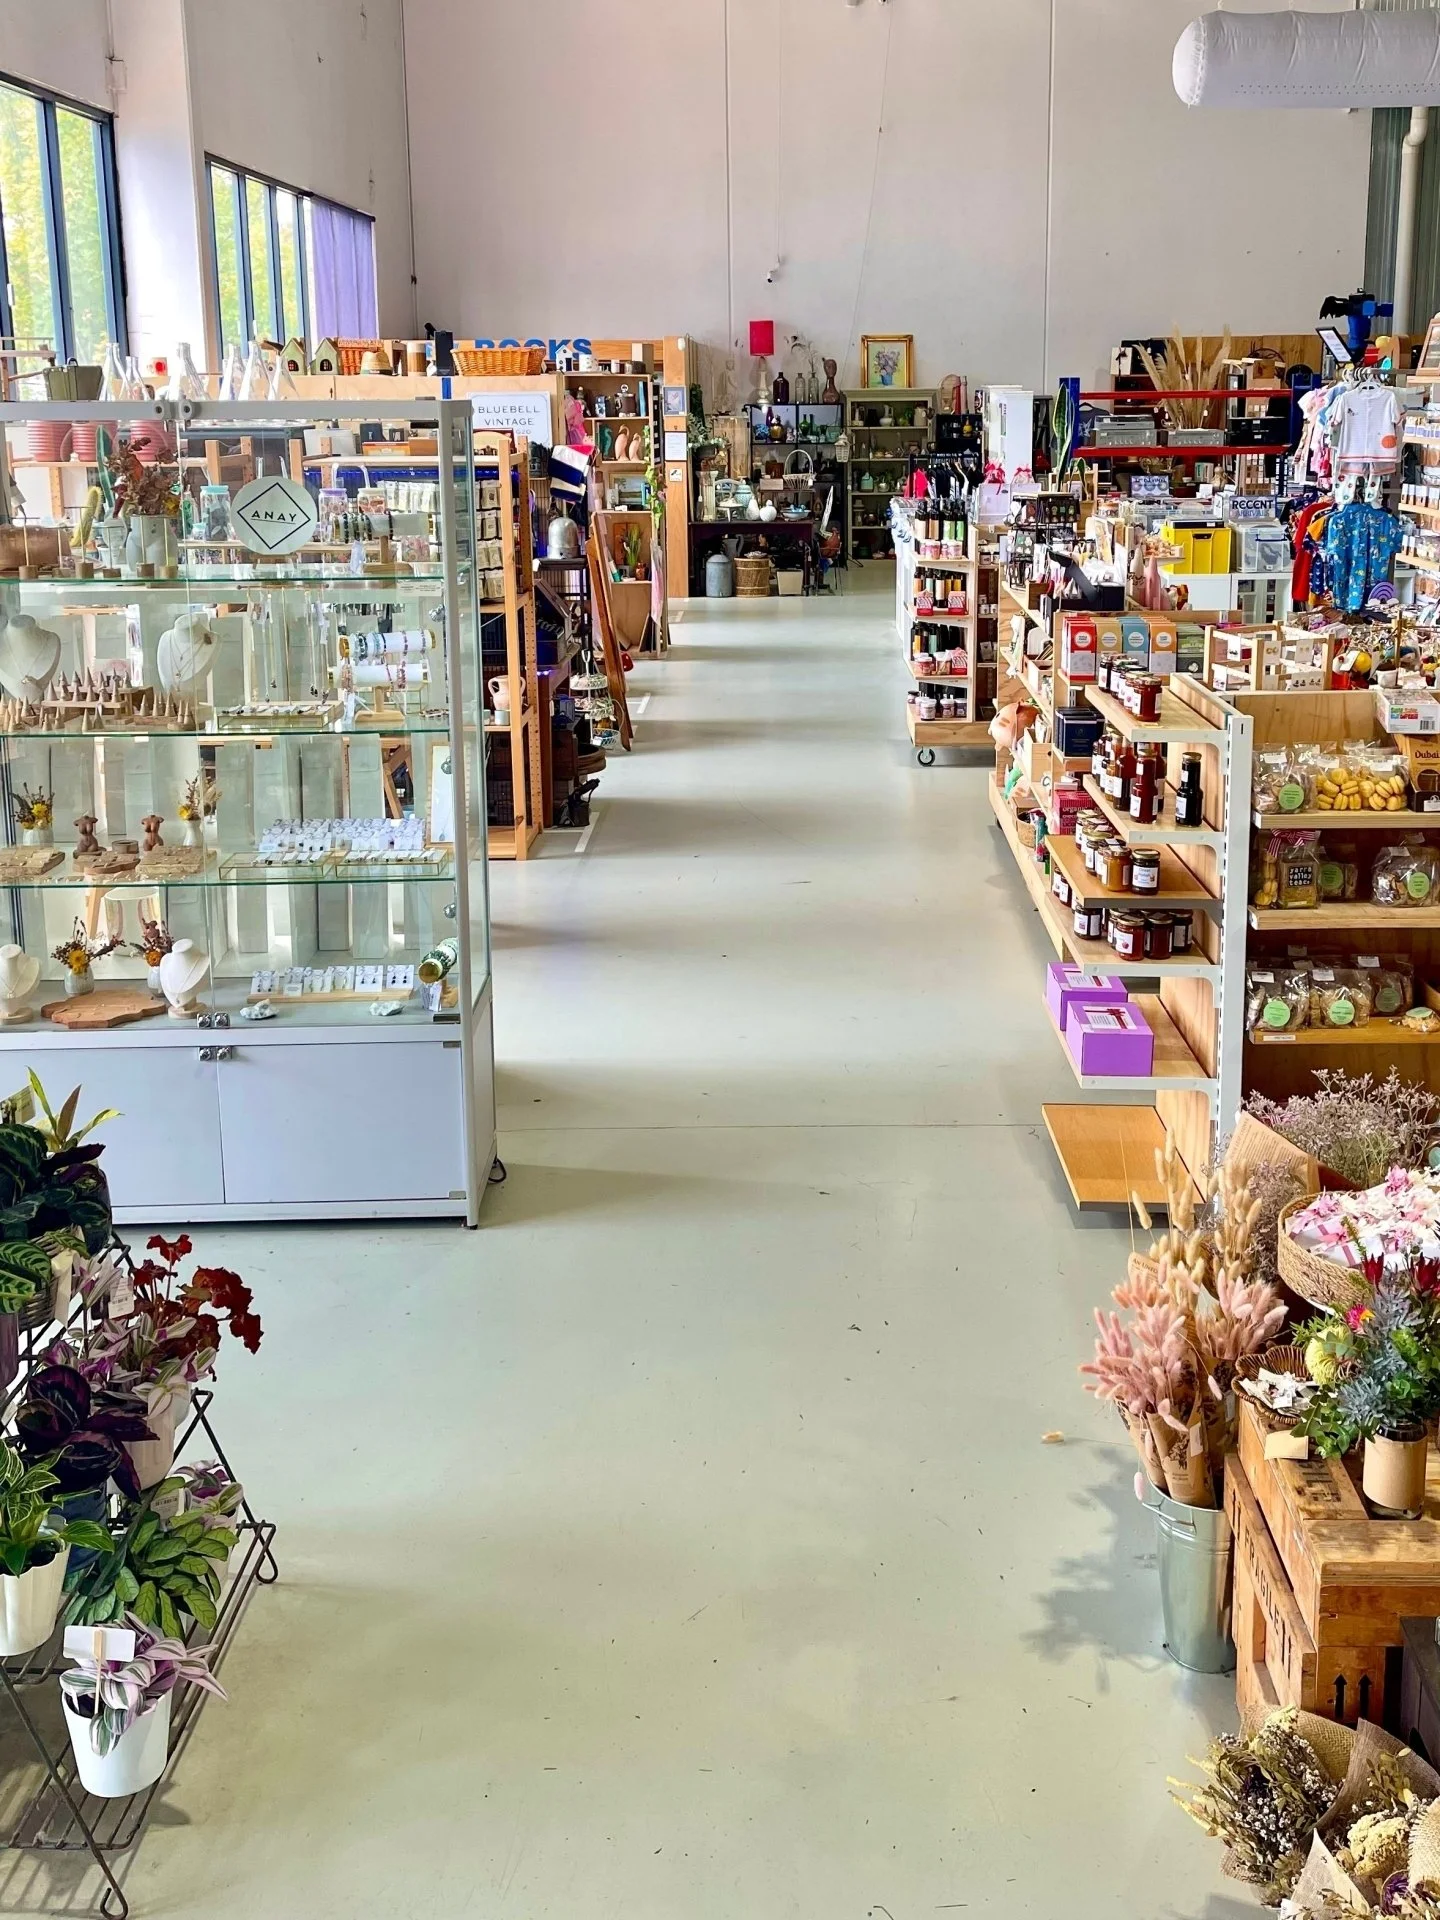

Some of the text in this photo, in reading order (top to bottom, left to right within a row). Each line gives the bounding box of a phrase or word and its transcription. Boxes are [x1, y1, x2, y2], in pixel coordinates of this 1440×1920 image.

[478, 405, 540, 414] BLUEBELL
[484, 417, 535, 426] VINTAGE
[1231, 499, 1274, 509] RECENT
[251, 510, 297, 522] ANAY
[1289, 866, 1312, 874] yarra
[1289, 872, 1313, 880] valley
[1244, 1525, 1279, 1635] FRAGILE
